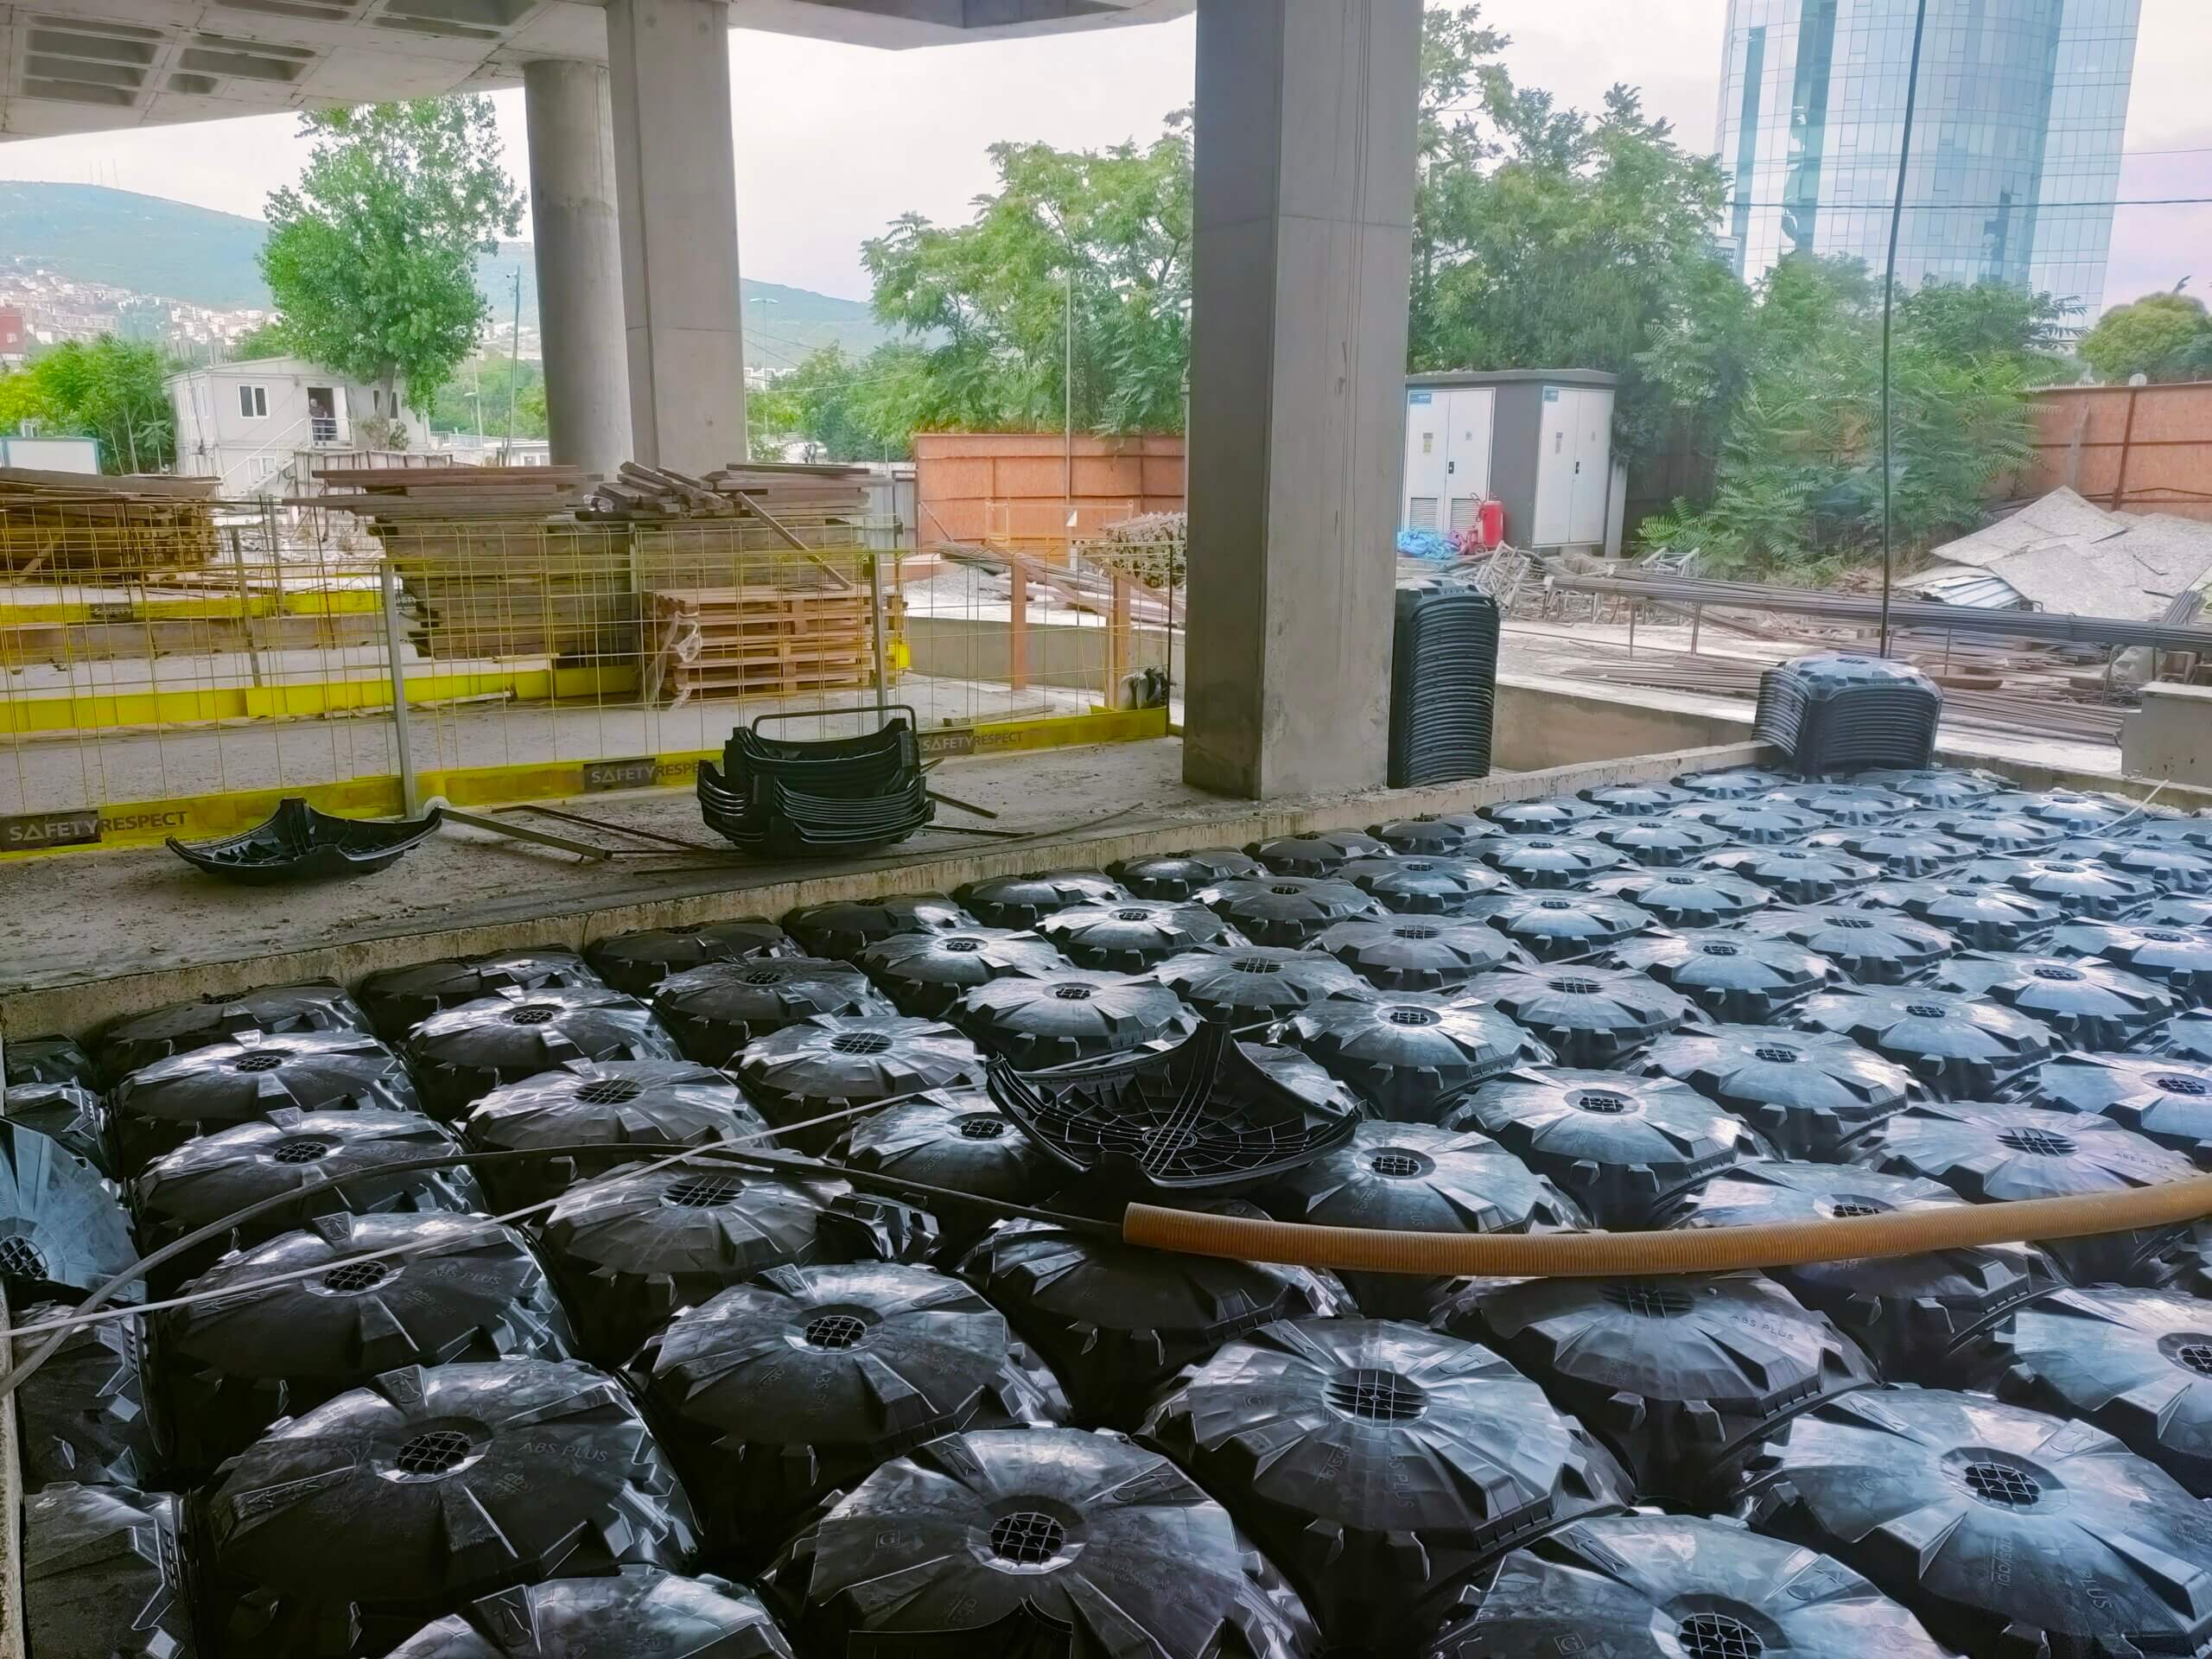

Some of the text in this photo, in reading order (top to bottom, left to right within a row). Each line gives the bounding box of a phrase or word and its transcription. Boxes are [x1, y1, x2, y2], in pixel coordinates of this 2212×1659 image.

[1729, 1315, 1795, 1341] ABS PLUS
[518, 1441, 608, 1462] ABS PLUS
[1394, 1473, 1414, 1508] PLUS
